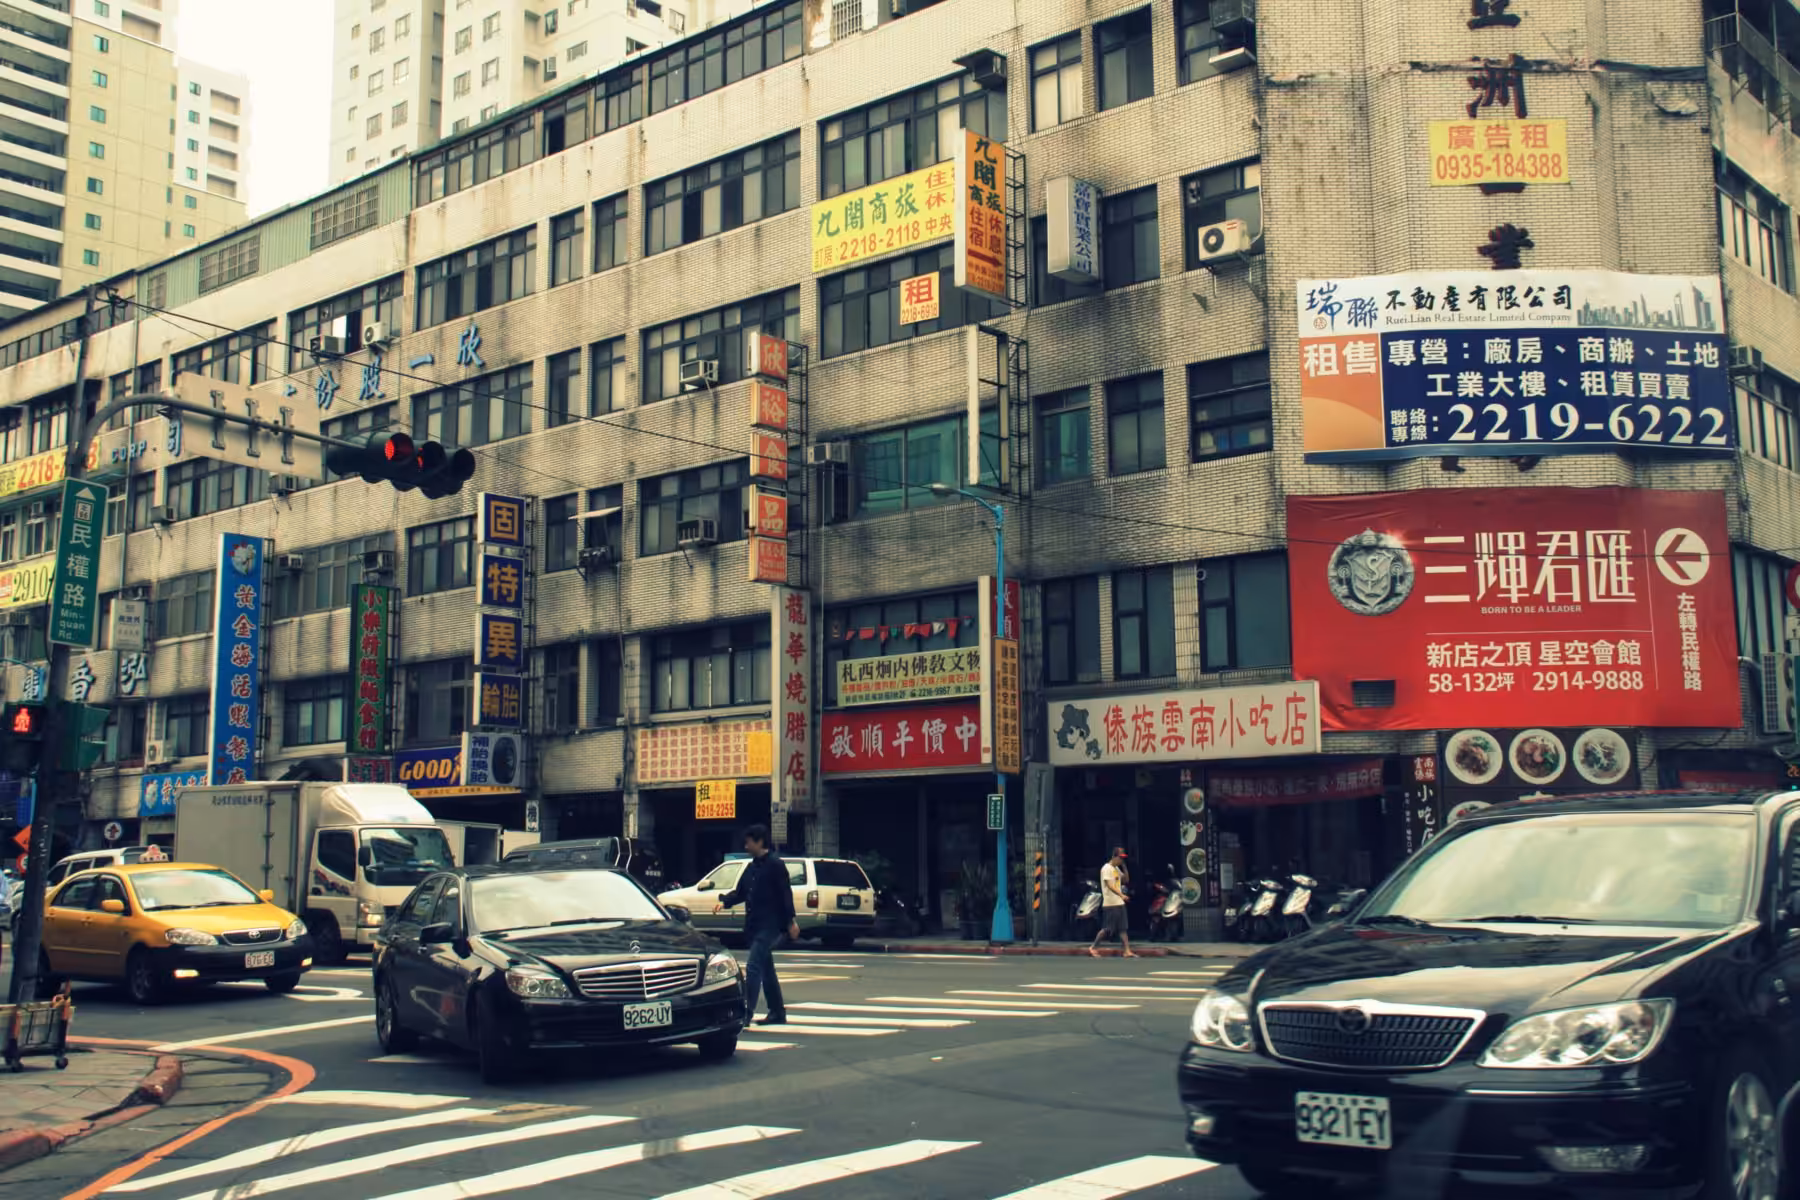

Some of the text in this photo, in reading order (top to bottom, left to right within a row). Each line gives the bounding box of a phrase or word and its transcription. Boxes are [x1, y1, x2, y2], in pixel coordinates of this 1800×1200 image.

[1448, 124, 1549, 150] 廣告租
[925, 166, 956, 189] 住
[1436, 153, 1562, 180] 0935-184388
[925, 191, 956, 210] 休
[840, 220, 920, 261] 2218-2118
[925, 213, 952, 236] 中央
[969, 206, 984, 247] 住宿
[905, 276, 933, 305] 租
[1305, 281, 1572, 332] 瑞聯 不動產有限公司
[1434, 314, 1455, 323] Real
[1458, 313, 1486, 322] Estate
[1489, 312, 1525, 322] Limited
[1528, 311, 1571, 323] Company
[1303, 341, 1377, 378] 租售
[1426, 371, 1691, 401] 工業大樓、租賃買賣
[1447, 402, 1727, 445] 2219-6222
[63, 522, 92, 608] 民權路
[1424, 530, 1637, 604] 三輝君匯
[60, 607, 85, 619] Min-
[482, 500, 519, 718] 固特異 輪胎
[1481, 606, 1508, 614] BORN
[1538, 605, 1545, 613] A
[1546, 605, 1582, 613] LEADER
[59, 619, 85, 631] quan
[1427, 640, 1641, 668] 新店之頂 星空會館
[1677, 592, 1703, 691] 左轉民權路
[1429, 671, 1643, 693] 58-132坪 2914-9888
[830, 715, 978, 759] 敏順平價中
[1104, 691, 1308, 754] 傣族雲南小吃店
[399, 758, 452, 781] GOOD
[697, 783, 711, 802] 租
